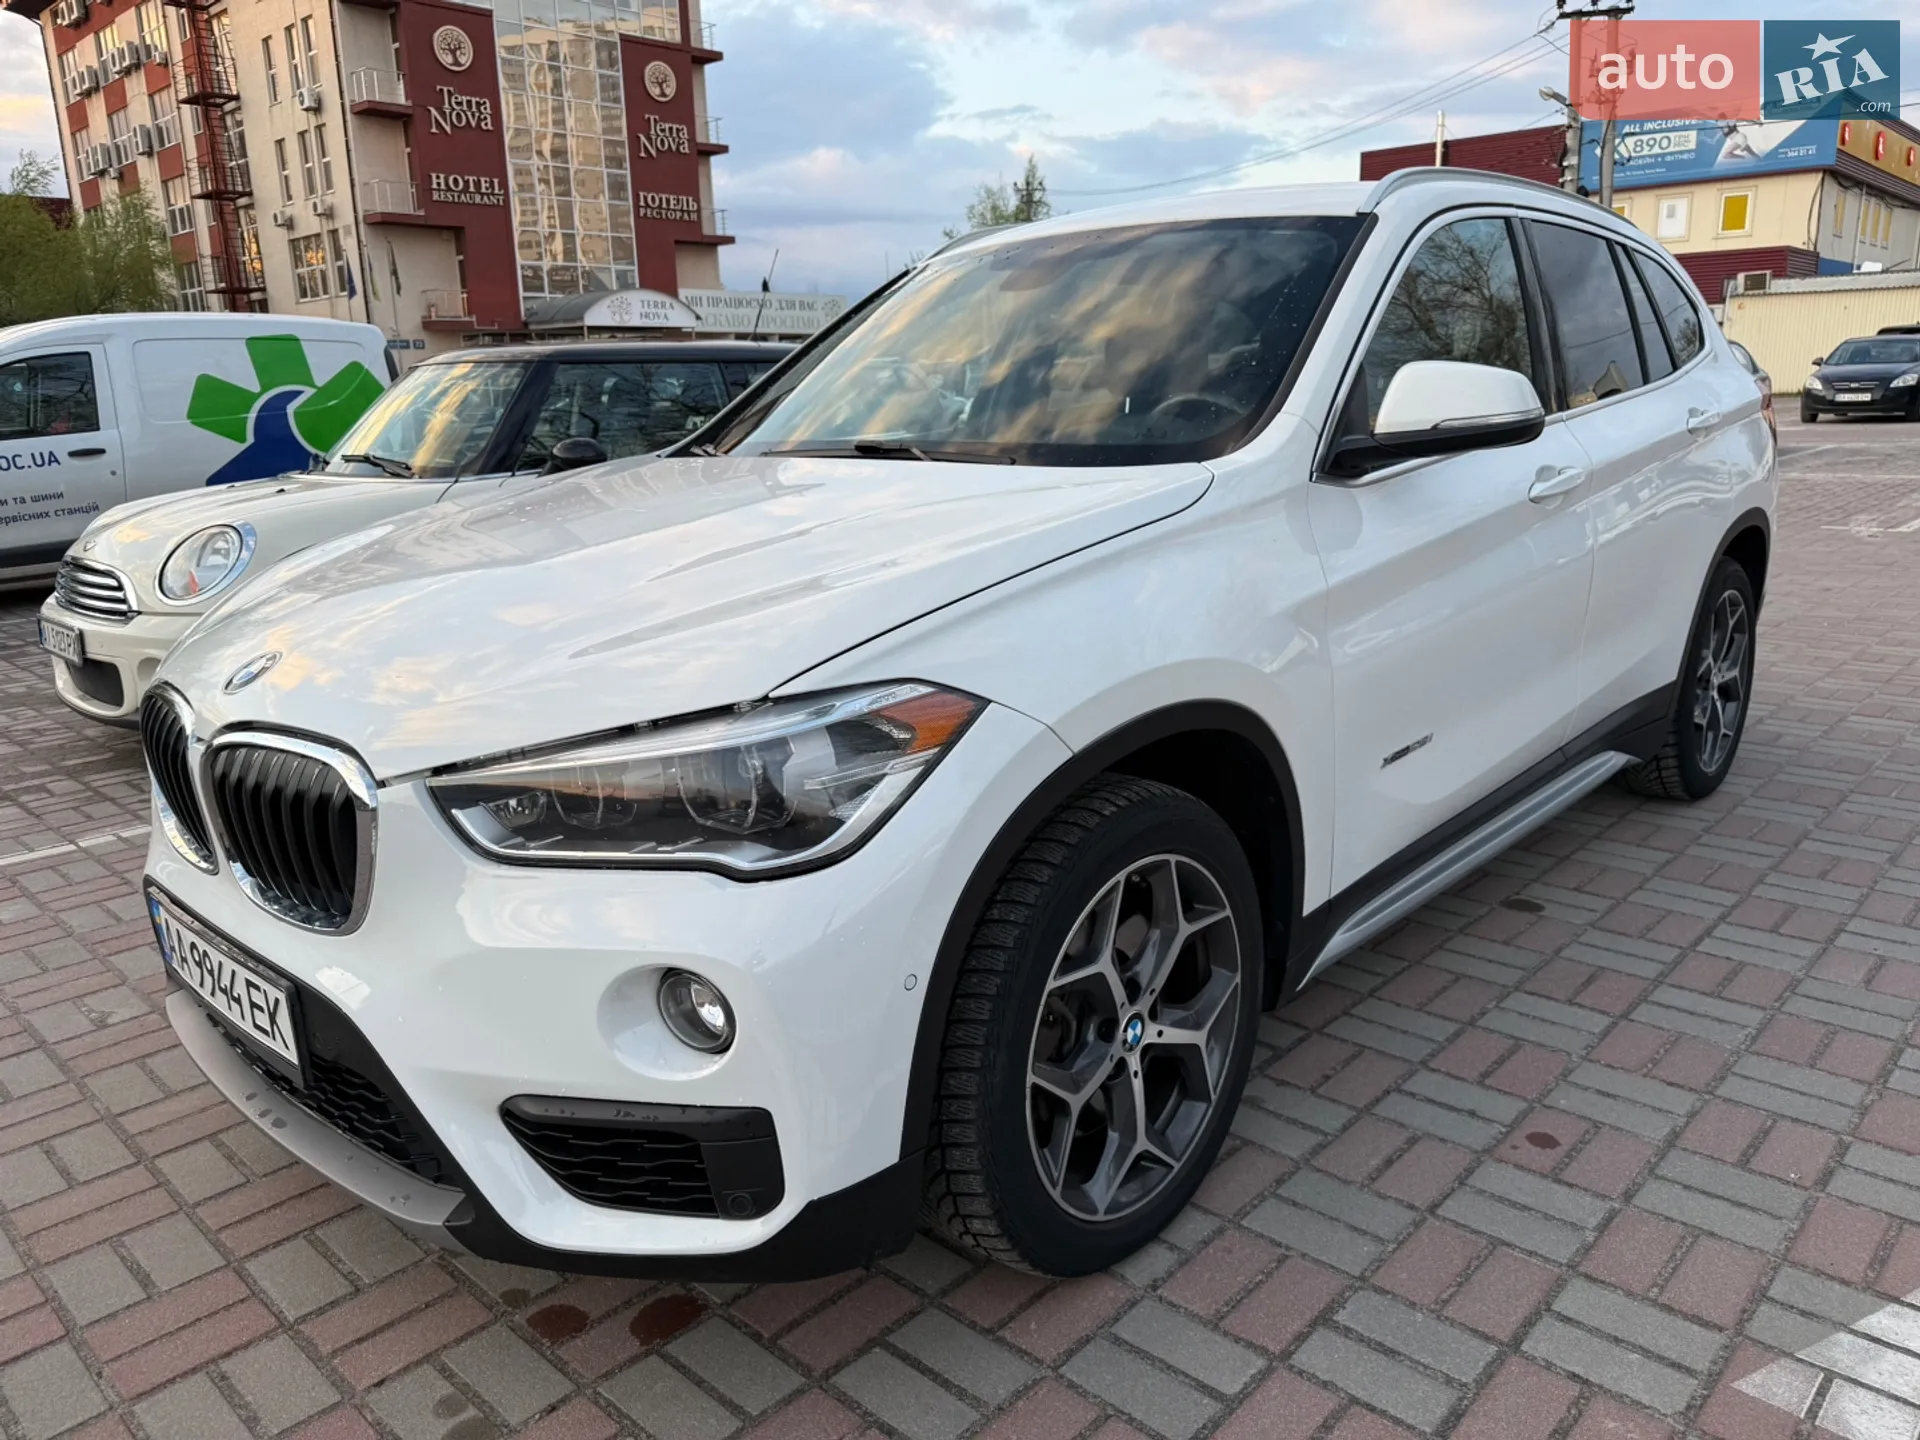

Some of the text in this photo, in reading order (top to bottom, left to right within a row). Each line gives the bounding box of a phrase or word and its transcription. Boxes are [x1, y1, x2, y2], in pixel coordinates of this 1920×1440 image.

[436, 85, 492, 114] Terra
[645, 114, 689, 139] Terra
[1622, 122, 1641, 133] ALL
[1632, 135, 1672, 154] 890
[430, 172, 504, 194] HOTEL
[432, 190, 505, 206] RESTAURANT
[638, 191, 698, 211] ГОТЕЛЬ
[639, 207, 698, 222] РЕСТОРАН
[640, 299, 674, 311] TERRA
[798, 299, 818, 311] ВАС
[640, 311, 669, 322] NOVA
[12, 496, 27, 505] та
[30, 491, 64, 504] шини
[54, 501, 100, 518] станцій
